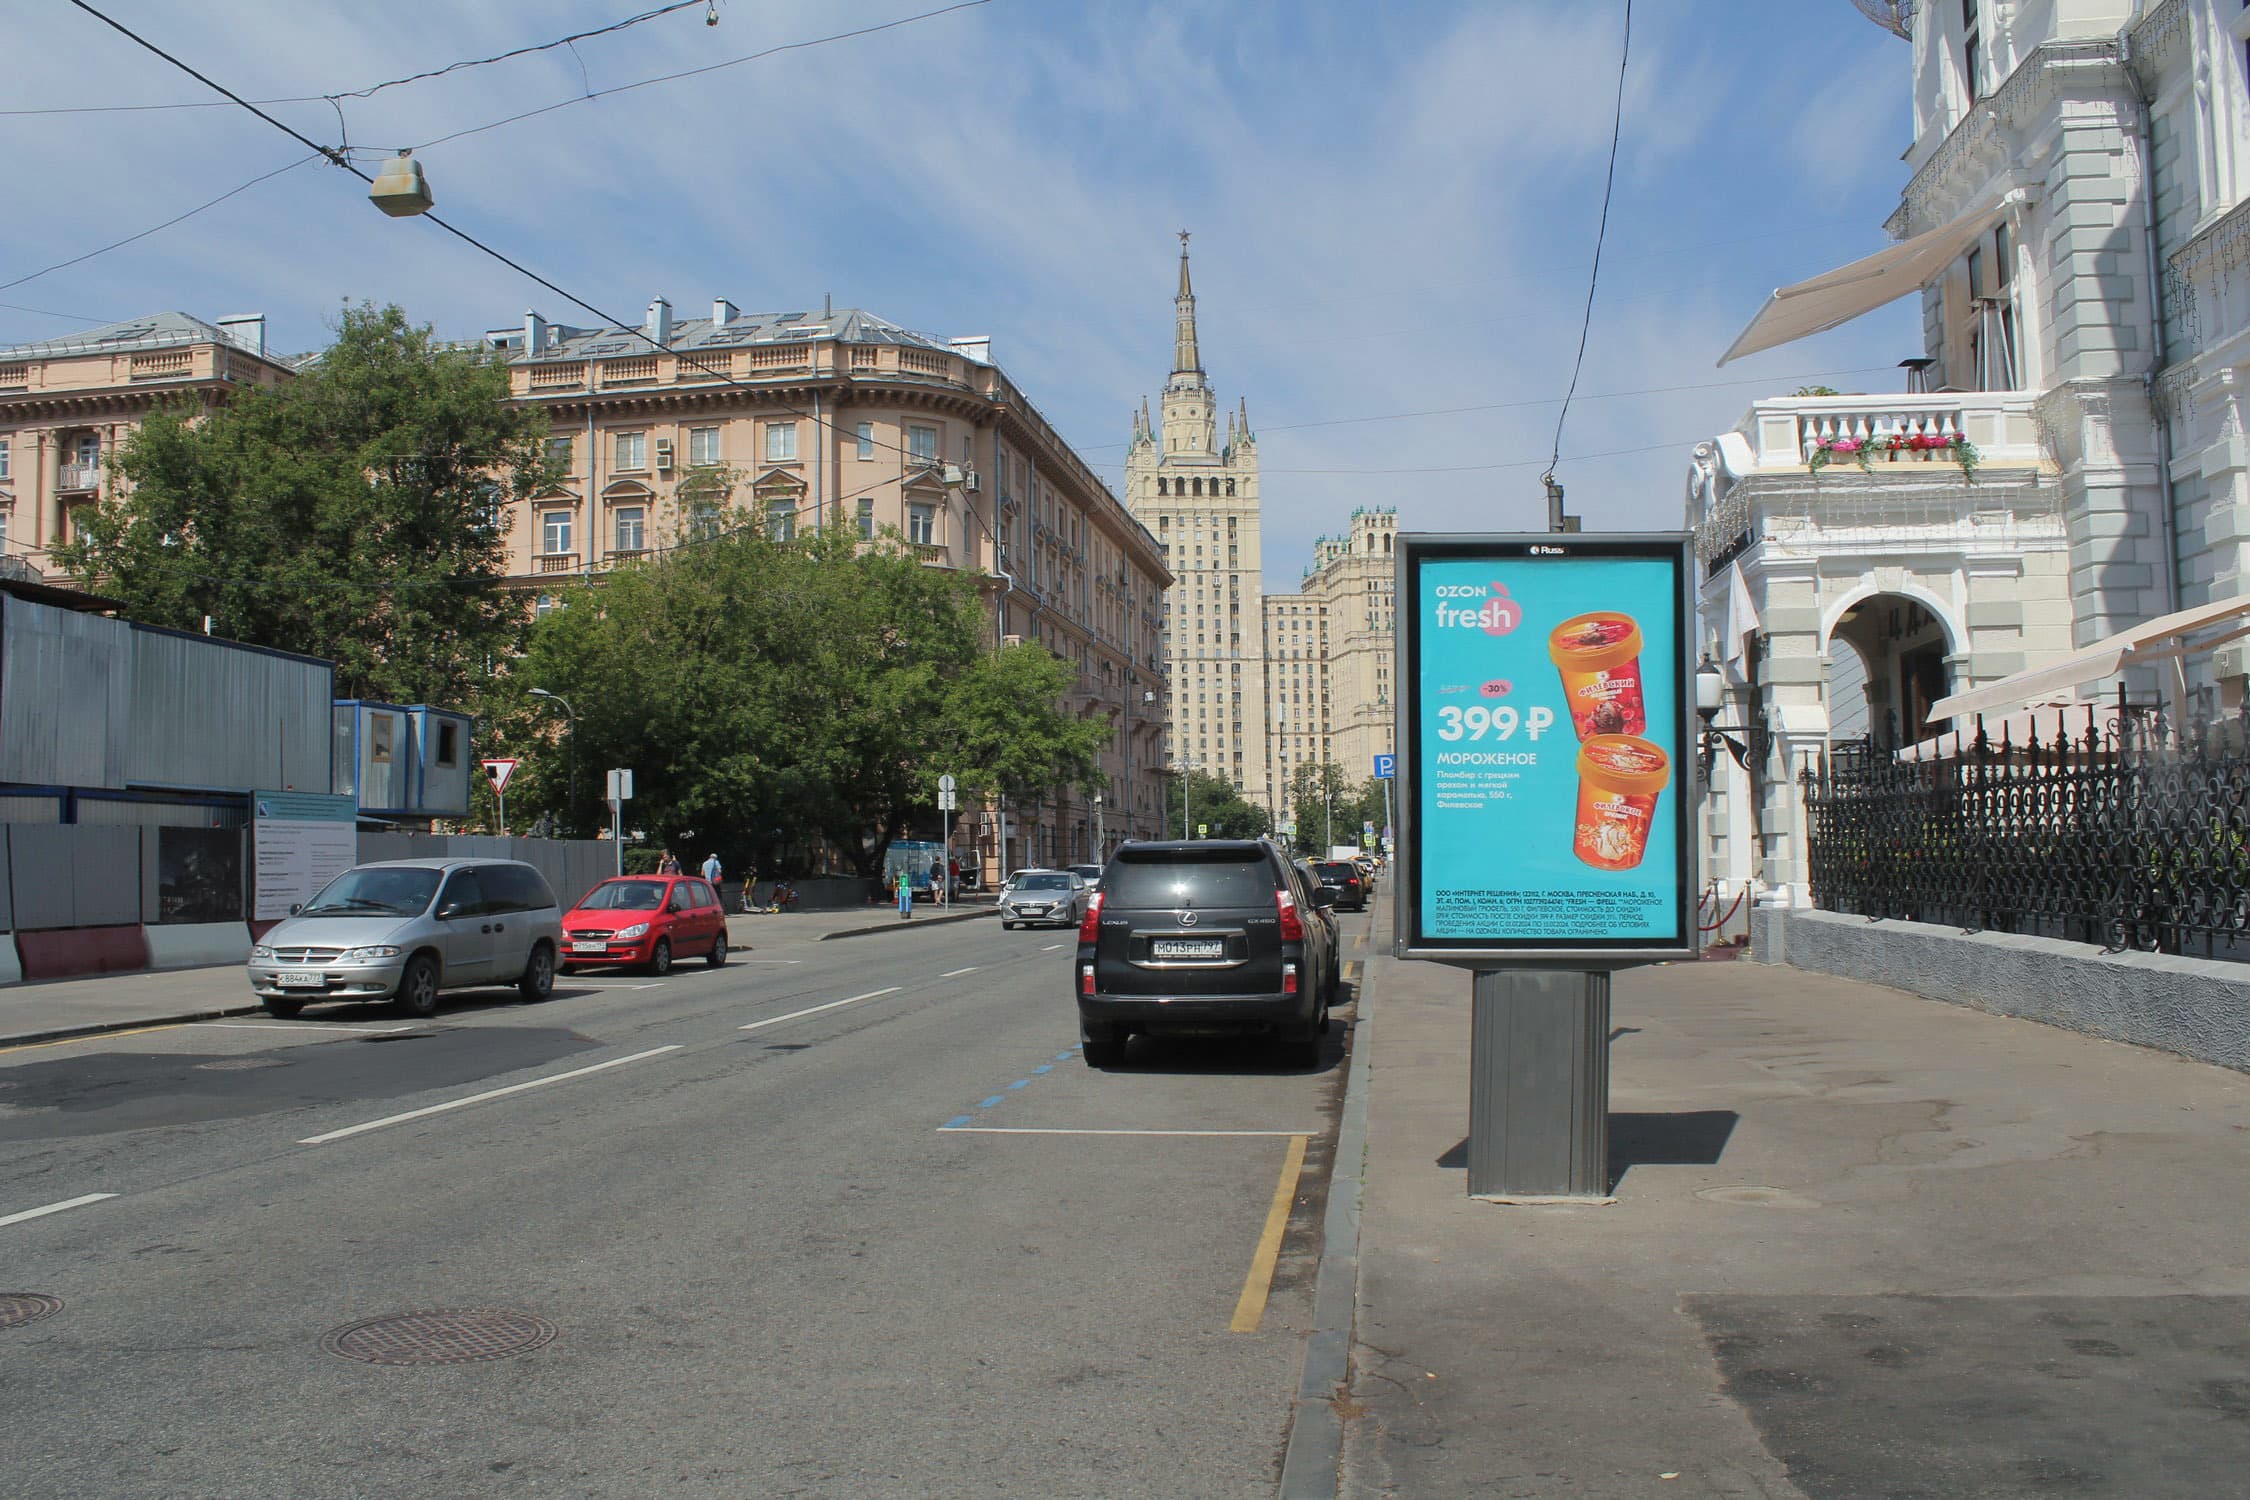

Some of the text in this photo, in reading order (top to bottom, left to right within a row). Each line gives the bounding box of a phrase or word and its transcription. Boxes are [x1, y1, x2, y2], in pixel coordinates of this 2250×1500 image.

[1436, 585, 1487, 597] OZON
[1435, 601, 1511, 628] fresh
[1438, 706, 1554, 741] 399 ₽
[1381, 756, 1393, 775] P
[1437, 752, 1537, 765] МОРОЖЕНОЕ
